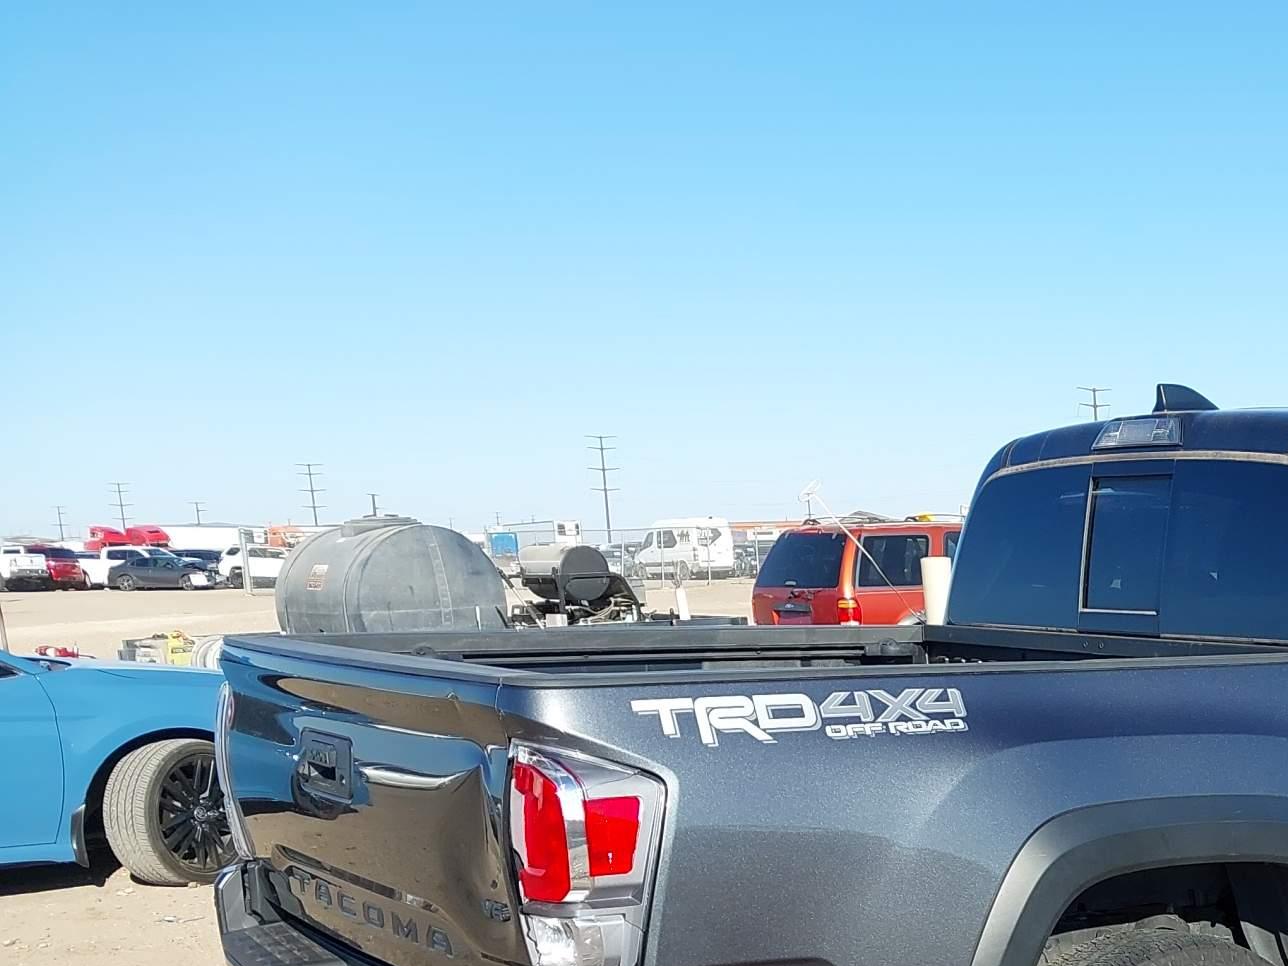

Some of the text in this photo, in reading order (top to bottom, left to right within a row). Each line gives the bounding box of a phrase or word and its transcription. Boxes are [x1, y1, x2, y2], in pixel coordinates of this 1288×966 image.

[630, 693, 822, 747] TRD
[825, 718, 969, 739] OFF ROAD
[288, 866, 454, 958] TACOMA
